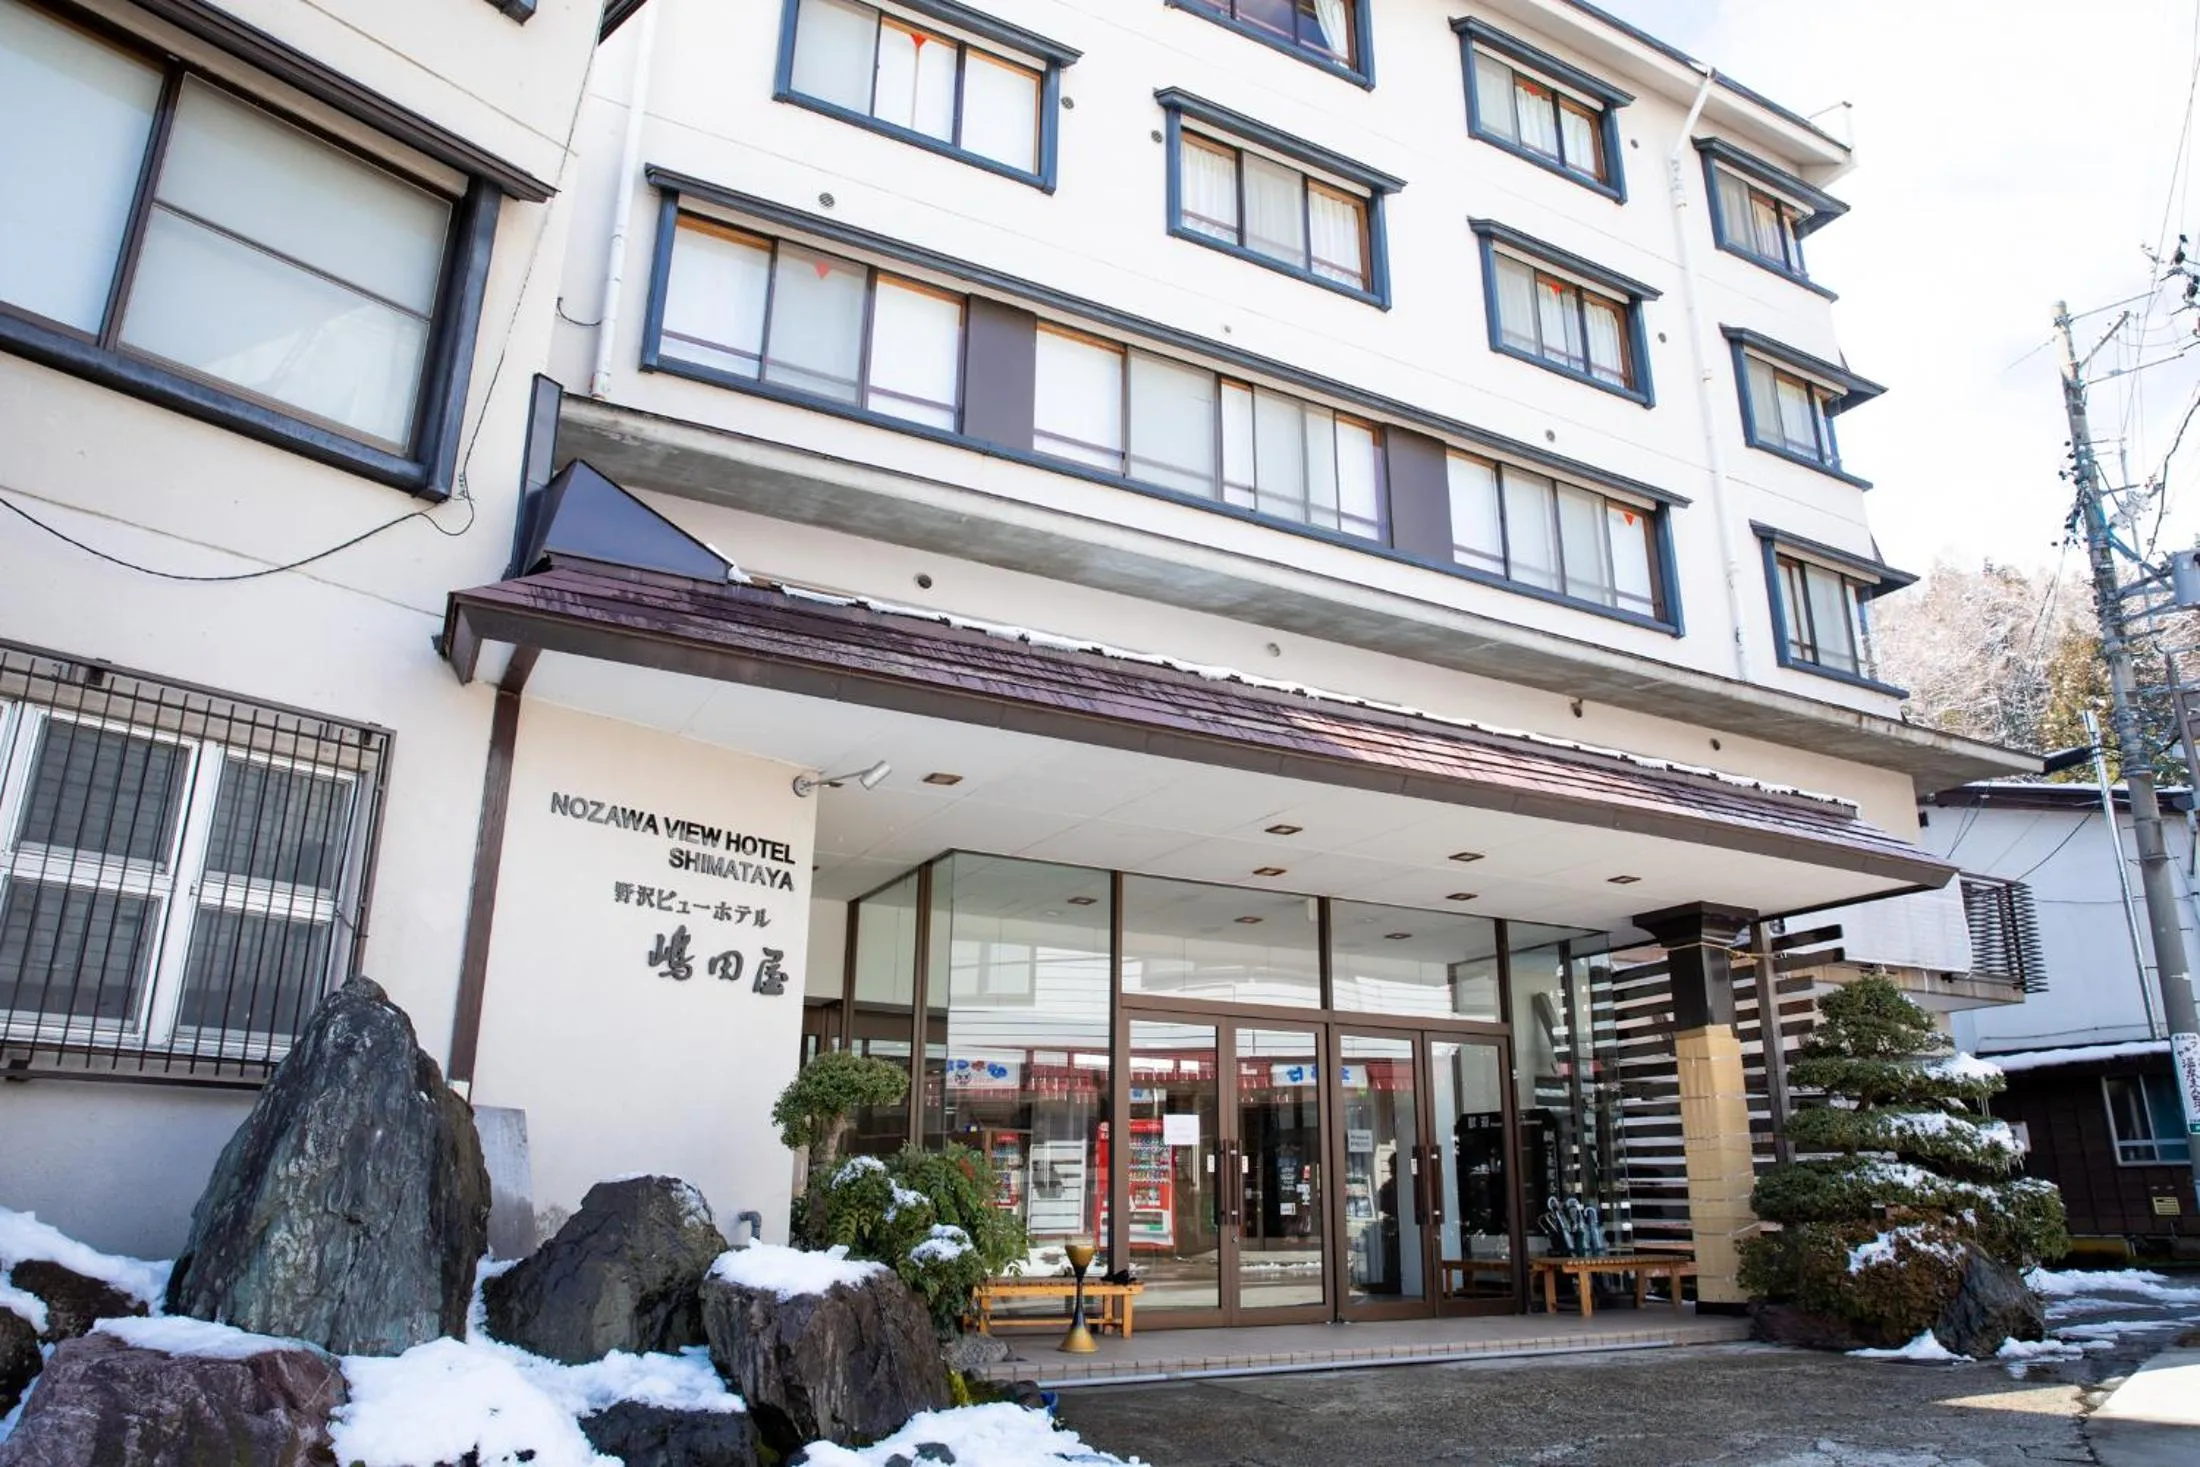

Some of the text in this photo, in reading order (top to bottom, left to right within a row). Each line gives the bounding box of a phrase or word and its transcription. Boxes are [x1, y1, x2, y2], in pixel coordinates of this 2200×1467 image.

[551, 791, 796, 865] NOZAWA VIEW HOTEL
[669, 848, 794, 892] SHIMATAYA
[614, 881, 771, 928] 野沢ビューホテル
[648, 925, 789, 995] 嶋田屋
